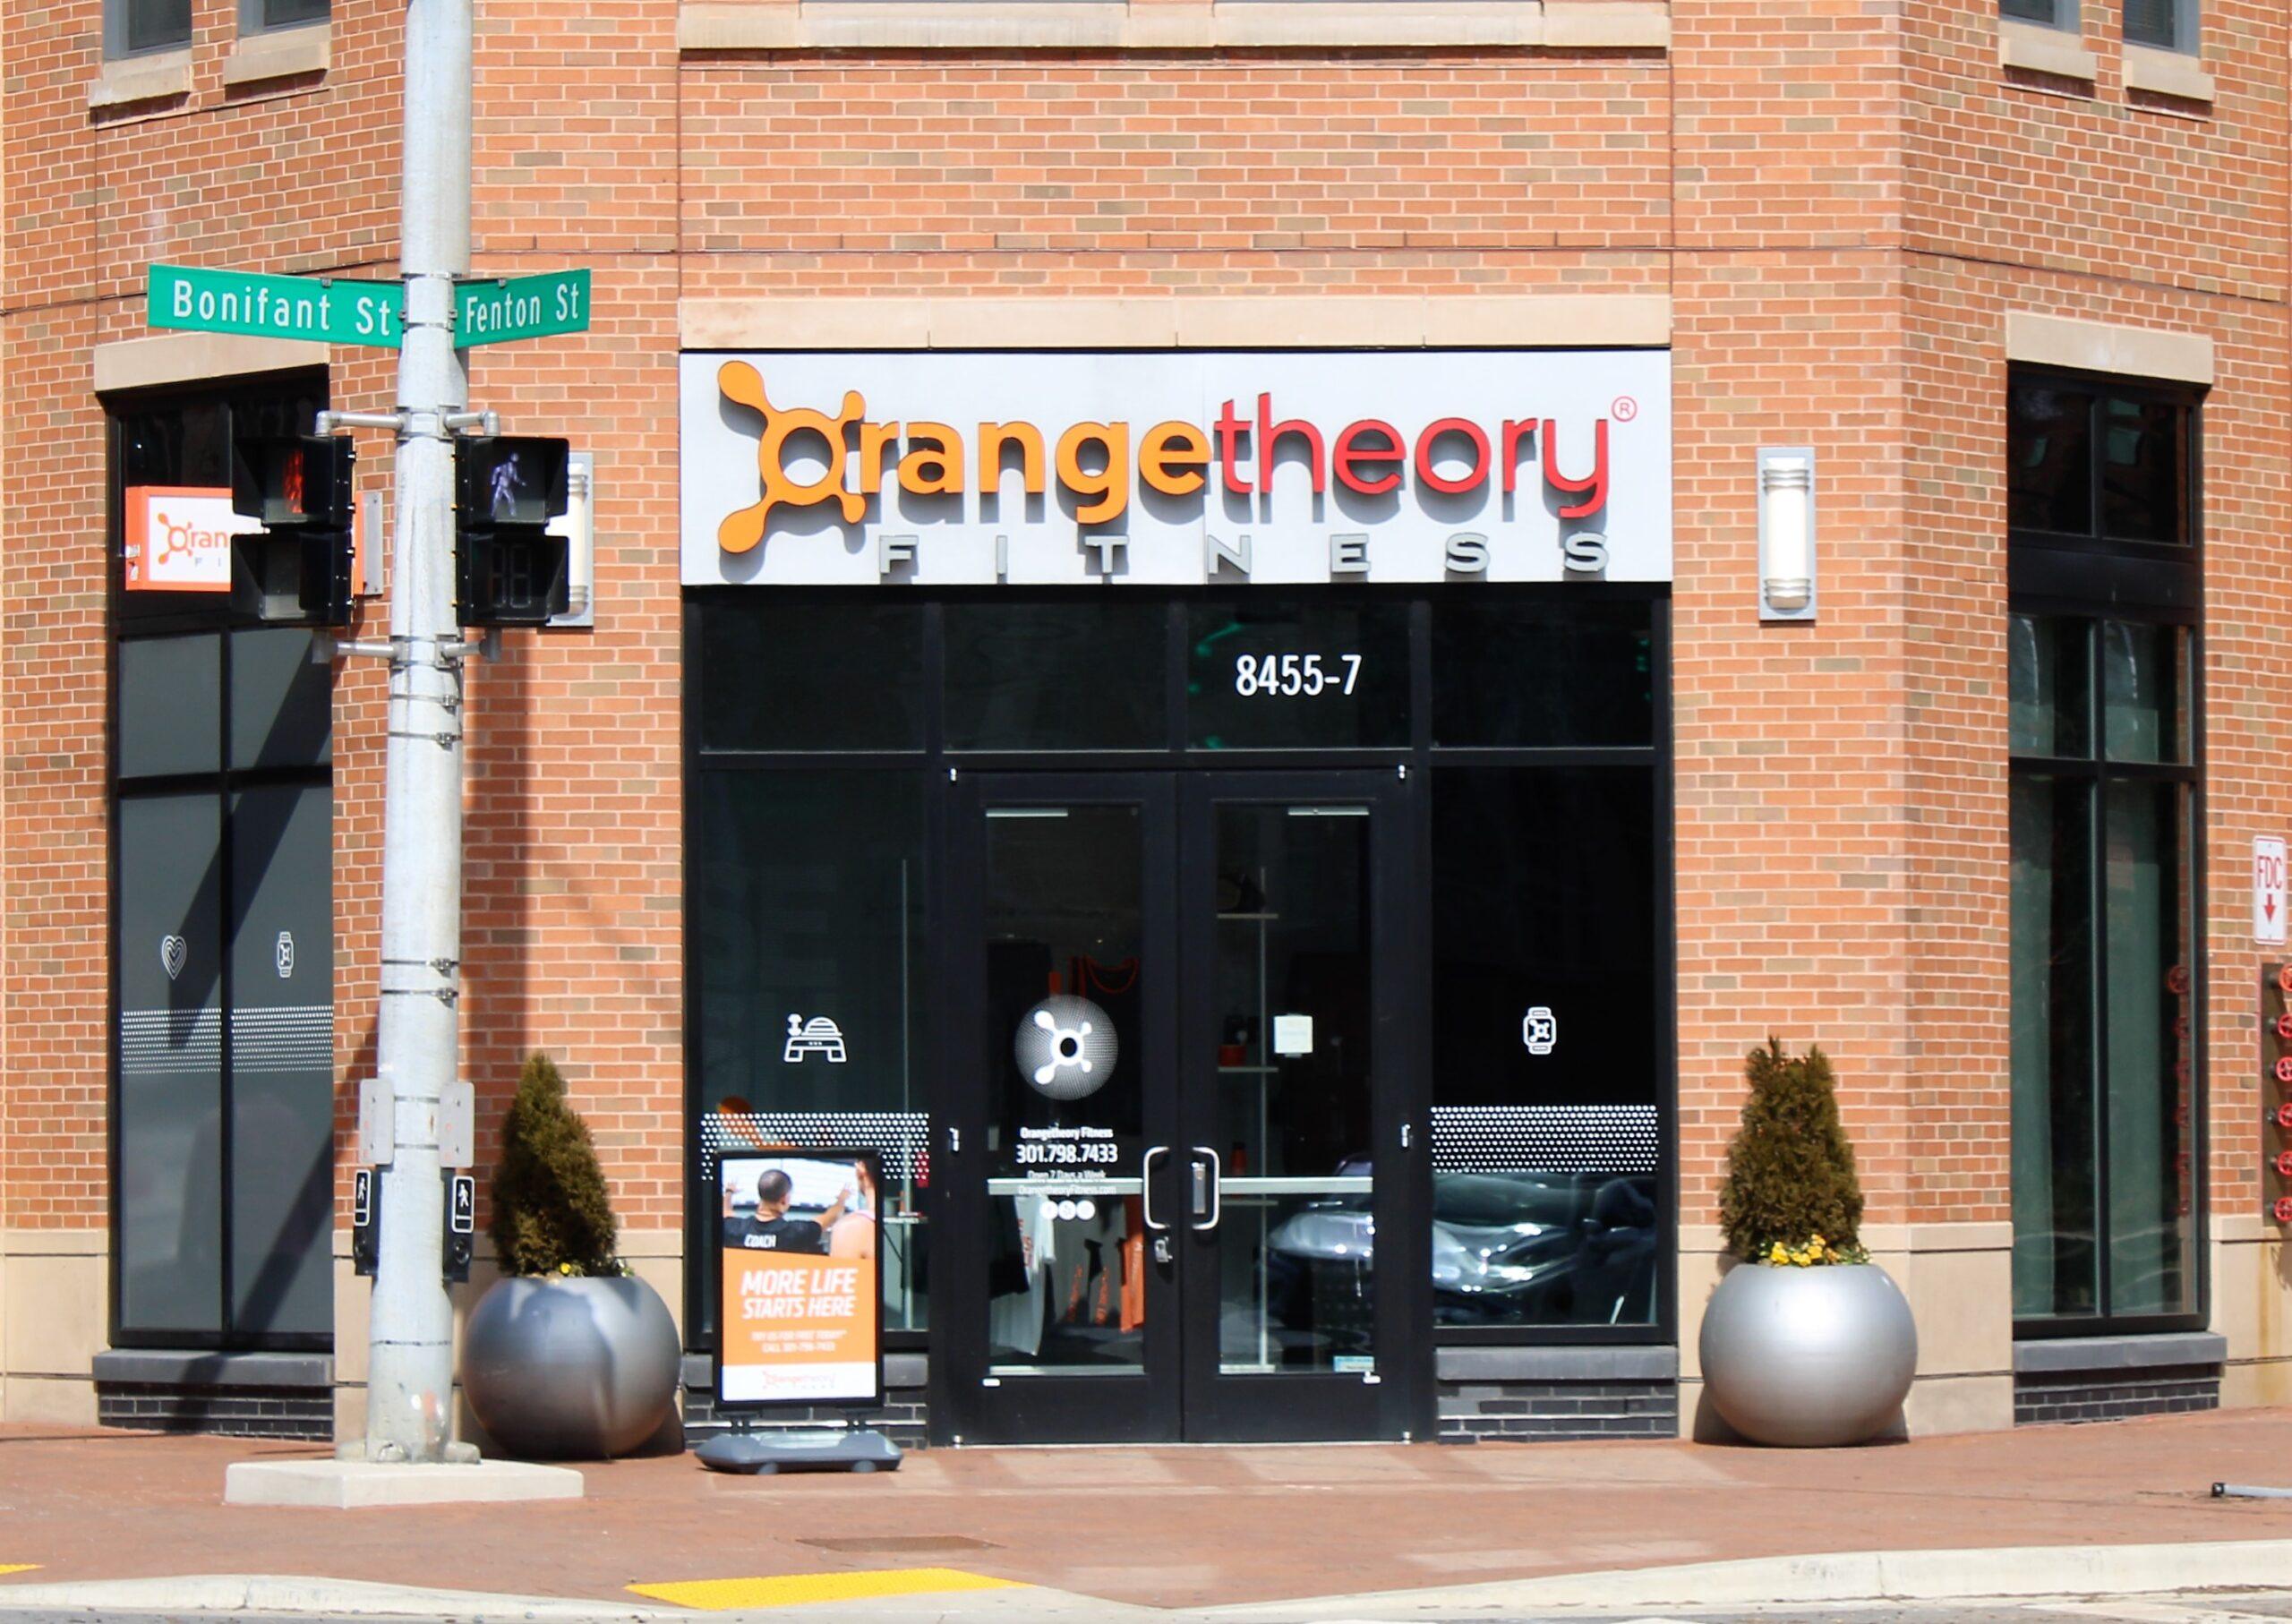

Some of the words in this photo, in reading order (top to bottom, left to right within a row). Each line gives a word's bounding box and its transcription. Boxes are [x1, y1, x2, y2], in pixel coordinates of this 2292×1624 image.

[173, 279, 330, 330] Bonifant
[356, 297, 391, 337] St
[466, 292, 541, 333] Fenton
[556, 282, 580, 321] St
[878, 532, 1610, 576] FITNESS
[1236, 654, 1363, 697] 8455-7
[2257, 855, 2283, 889] FDC
[1081, 1126, 1114, 1139] Fitness
[1016, 1143, 1118, 1164] 301.798.7433
[744, 1234, 777, 1248] COACH
[740, 1269, 808, 1296] MORE
[809, 1267, 860, 1295] LIFE
[741, 1296, 807, 1321] STARTS
[807, 1295, 857, 1318] HERE
